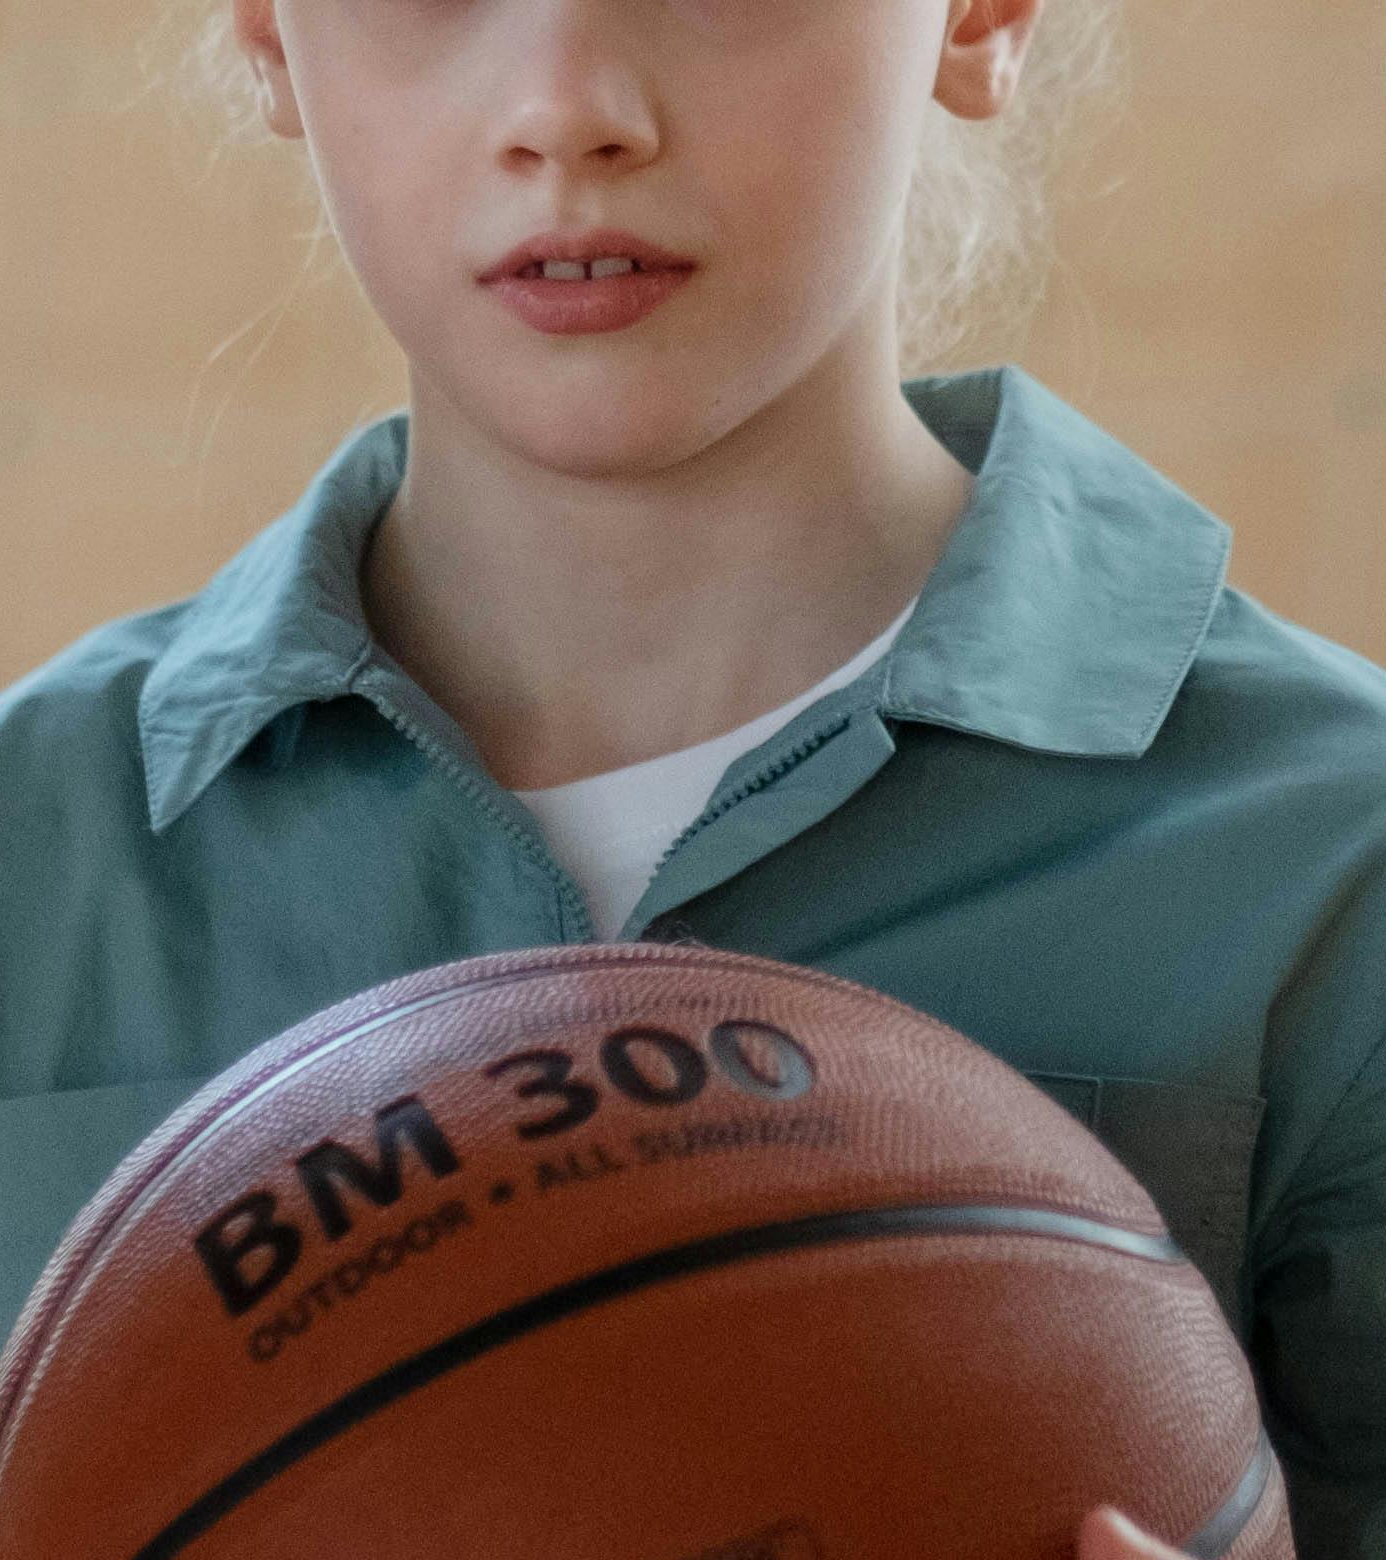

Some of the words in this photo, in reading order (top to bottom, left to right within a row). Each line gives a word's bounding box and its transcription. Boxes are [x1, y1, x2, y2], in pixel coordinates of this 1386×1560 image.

[193, 1093, 463, 1319] BM
[483, 1017, 817, 1144] 300
[246, 1198, 473, 1364] OUTDOOR
[534, 1143, 625, 1192] ALL
